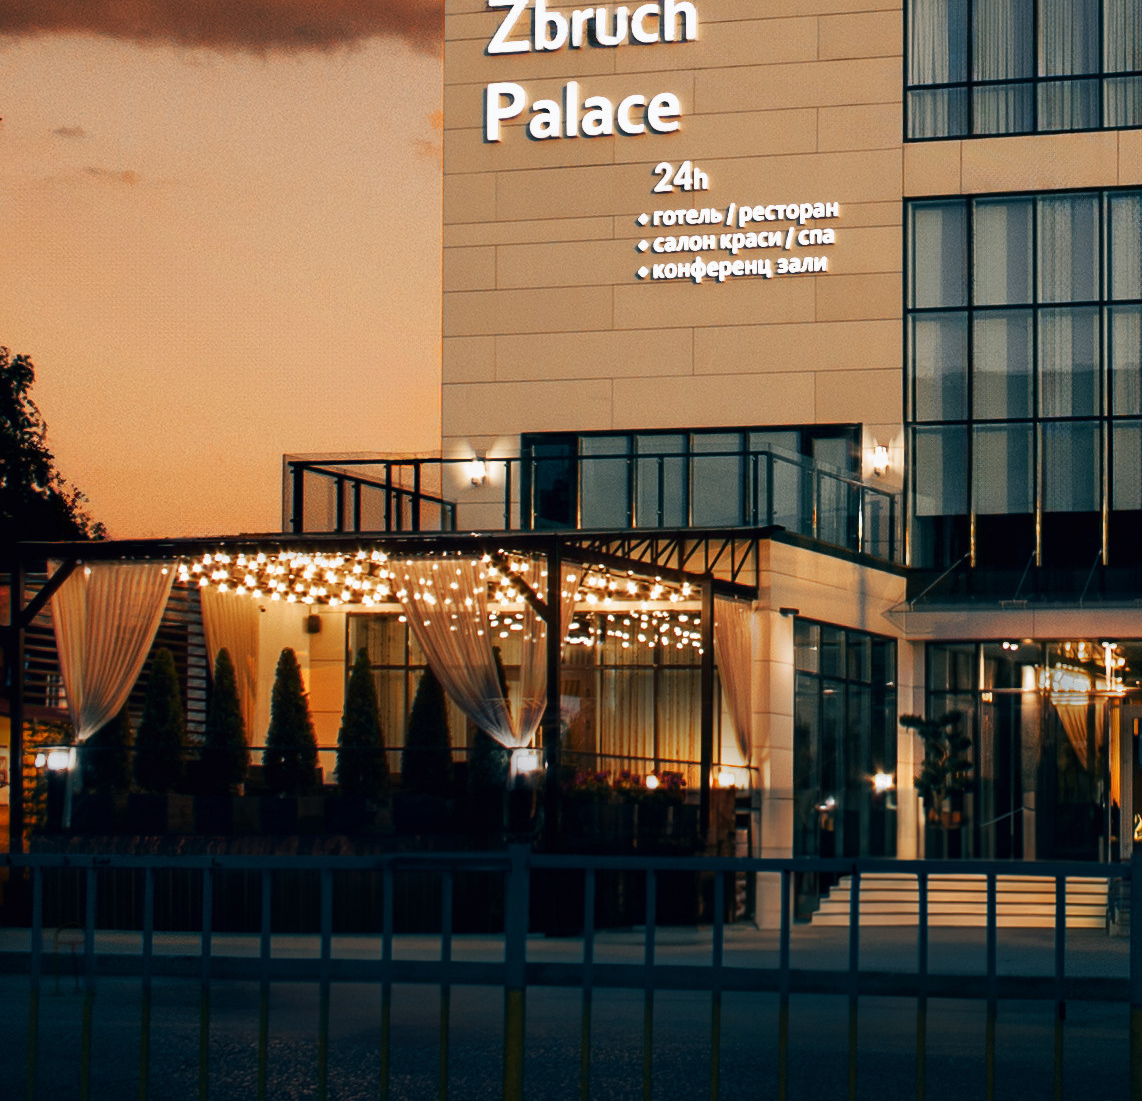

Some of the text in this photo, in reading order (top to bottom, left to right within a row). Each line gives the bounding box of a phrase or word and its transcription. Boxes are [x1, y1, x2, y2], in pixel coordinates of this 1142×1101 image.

[486, 80, 682, 141] Palace
[653, 160, 710, 193] 24h
[652, 207, 724, 227] готель
[738, 201, 840, 228] ресторан
[652, 234, 717, 253] салон
[719, 230, 783, 255] краси
[797, 228, 836, 246] спа
[652, 255, 828, 284] конференц зали
